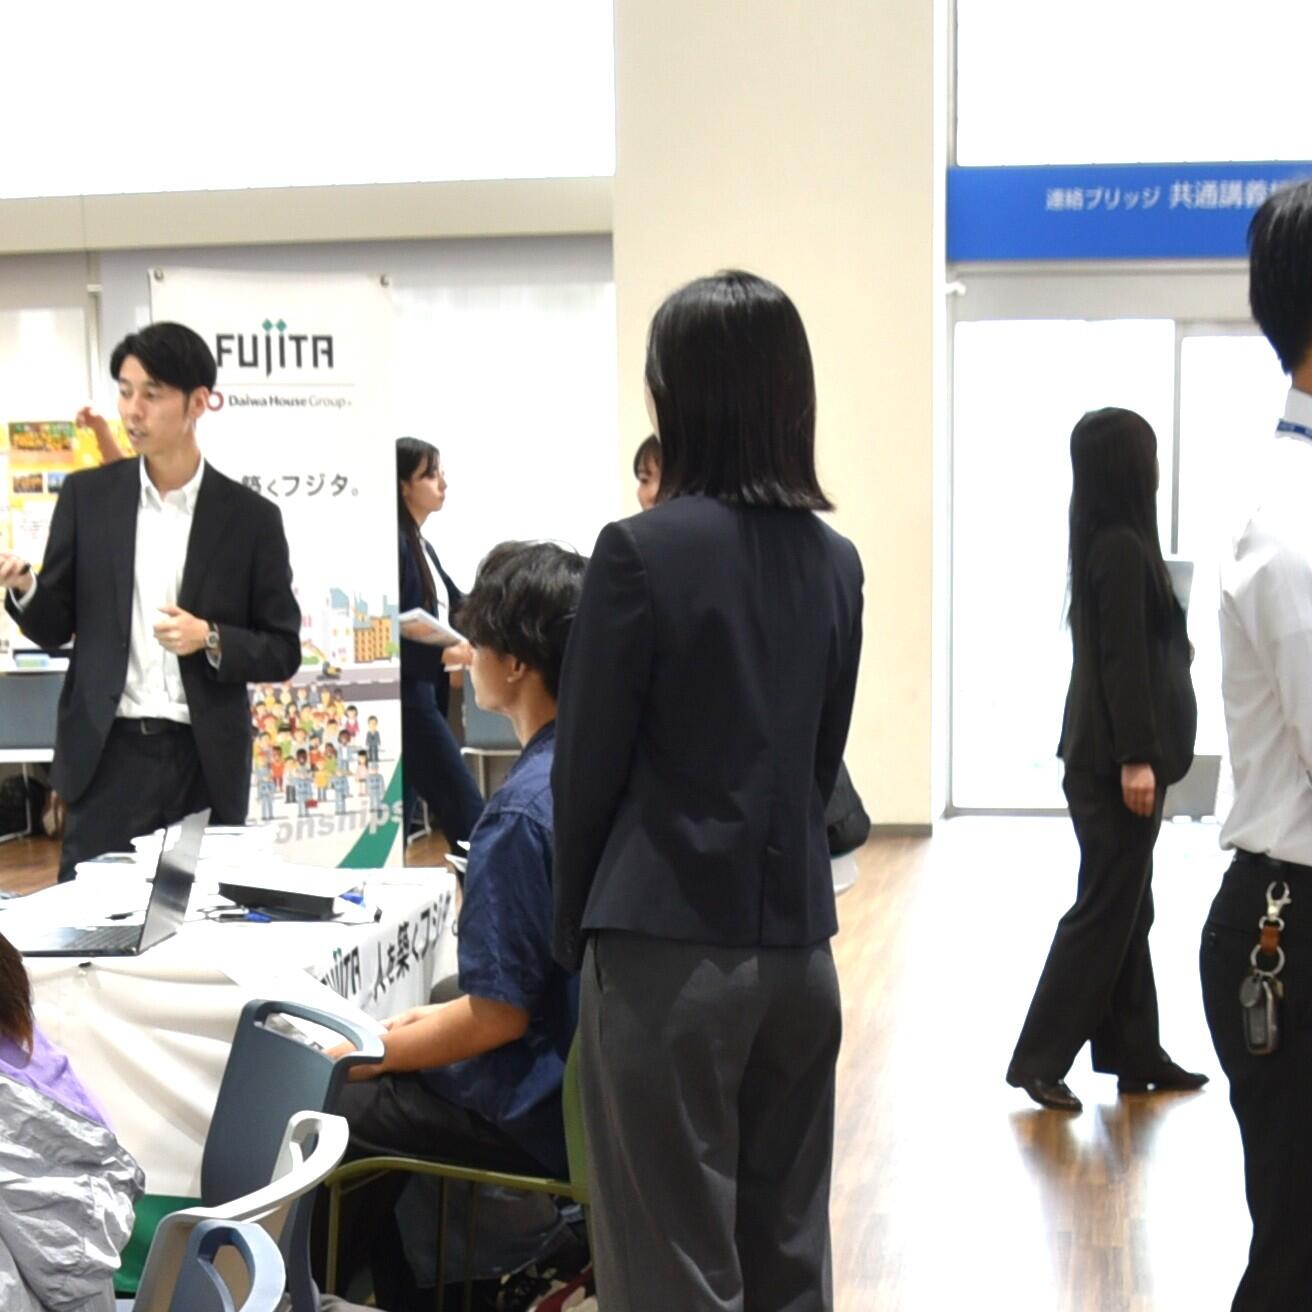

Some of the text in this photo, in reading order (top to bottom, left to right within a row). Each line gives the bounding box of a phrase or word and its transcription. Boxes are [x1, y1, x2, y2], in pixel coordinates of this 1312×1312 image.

[1045, 179, 1285, 211] 連絡ブリッジ 共通講義
[215, 318, 334, 378] FUJITA
[229, 393, 268, 407] Daiwa
[269, 394, 307, 407] House
